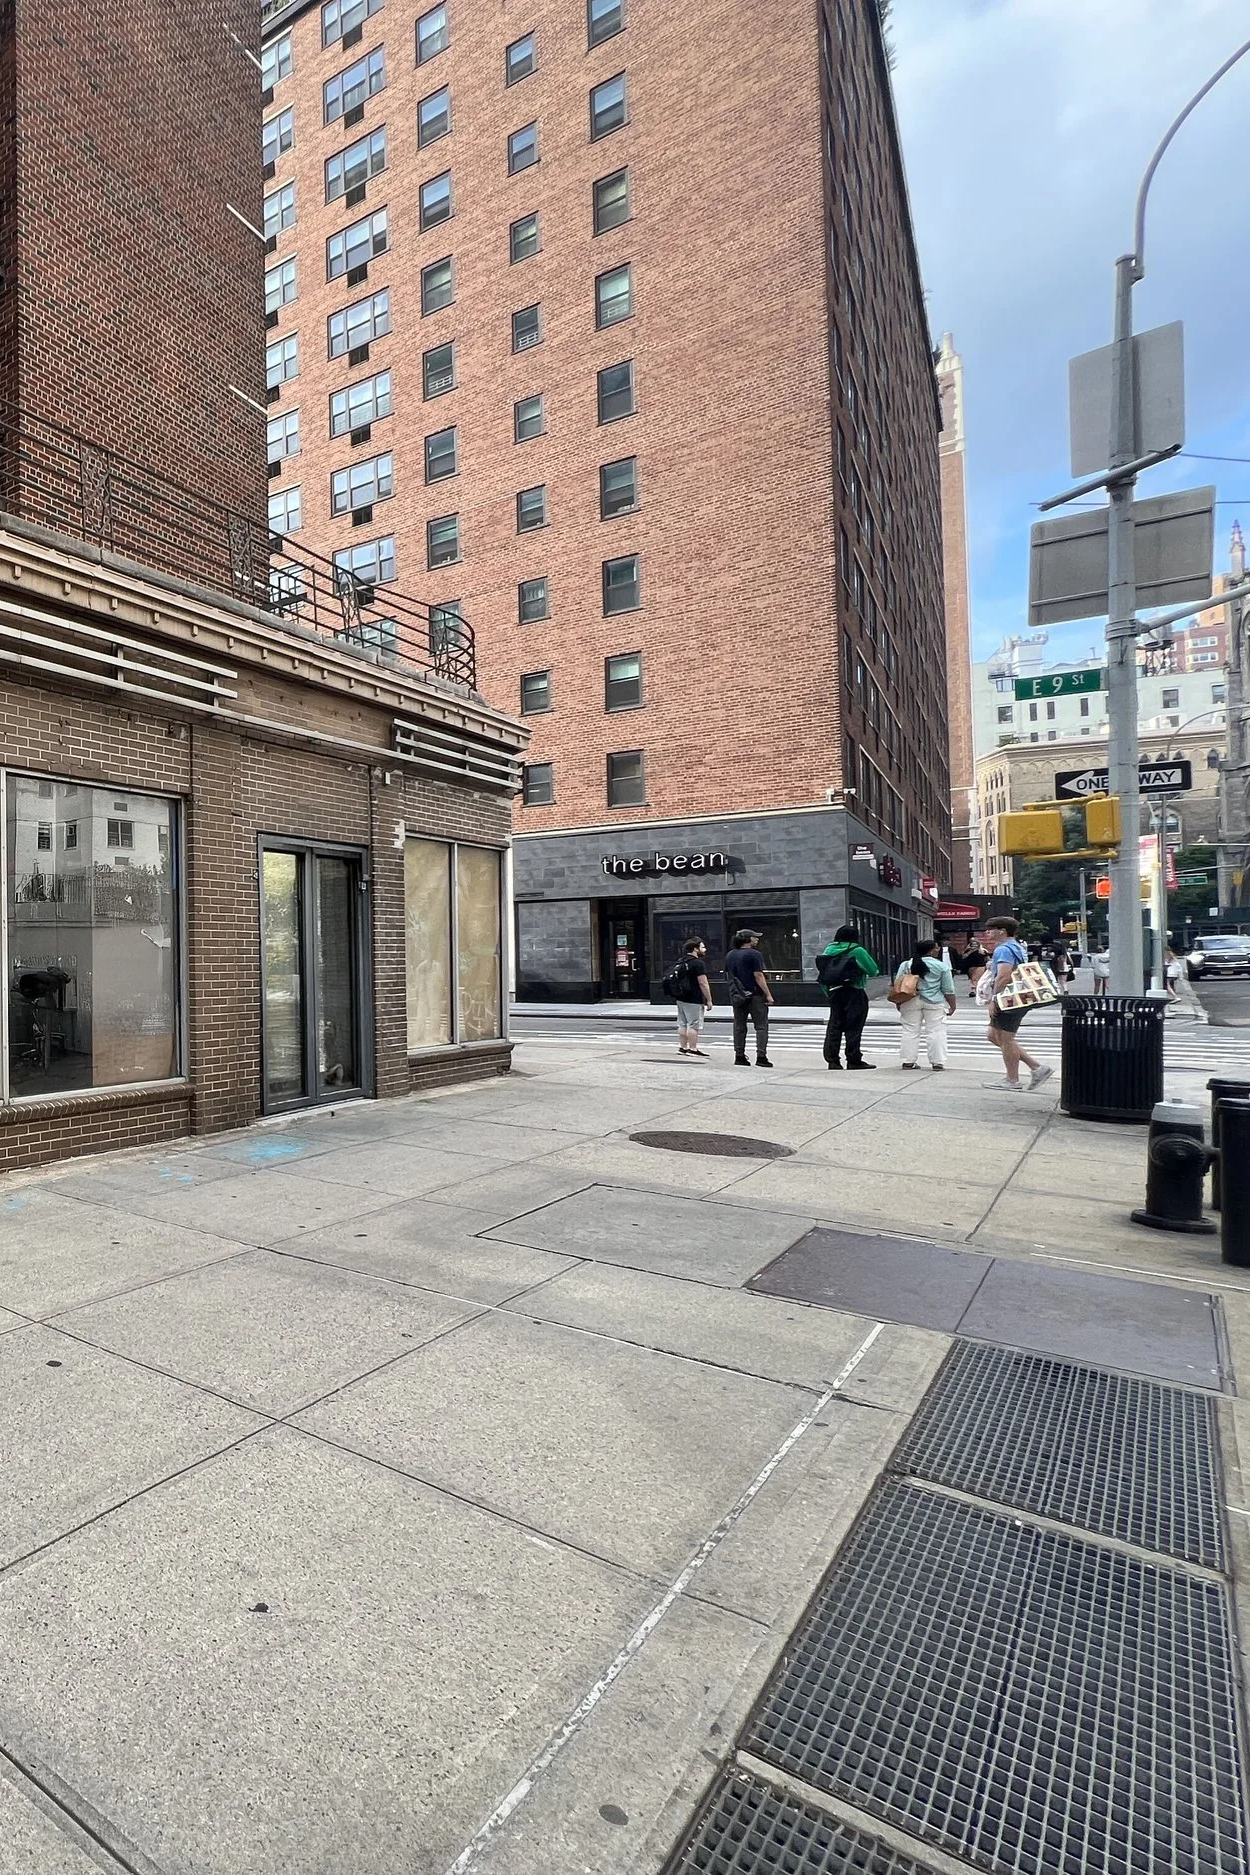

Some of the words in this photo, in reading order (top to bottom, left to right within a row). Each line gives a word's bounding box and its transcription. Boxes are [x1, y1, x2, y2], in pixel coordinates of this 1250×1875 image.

[1032, 679, 1042, 696] E
[1052, 676, 1064, 694] 9
[1072, 673, 1085, 686] St
[1076, 776, 1109, 790] ONE
[1139, 770, 1176, 784] WAY
[602, 855, 644, 874] the
[655, 852, 724, 870] bean
